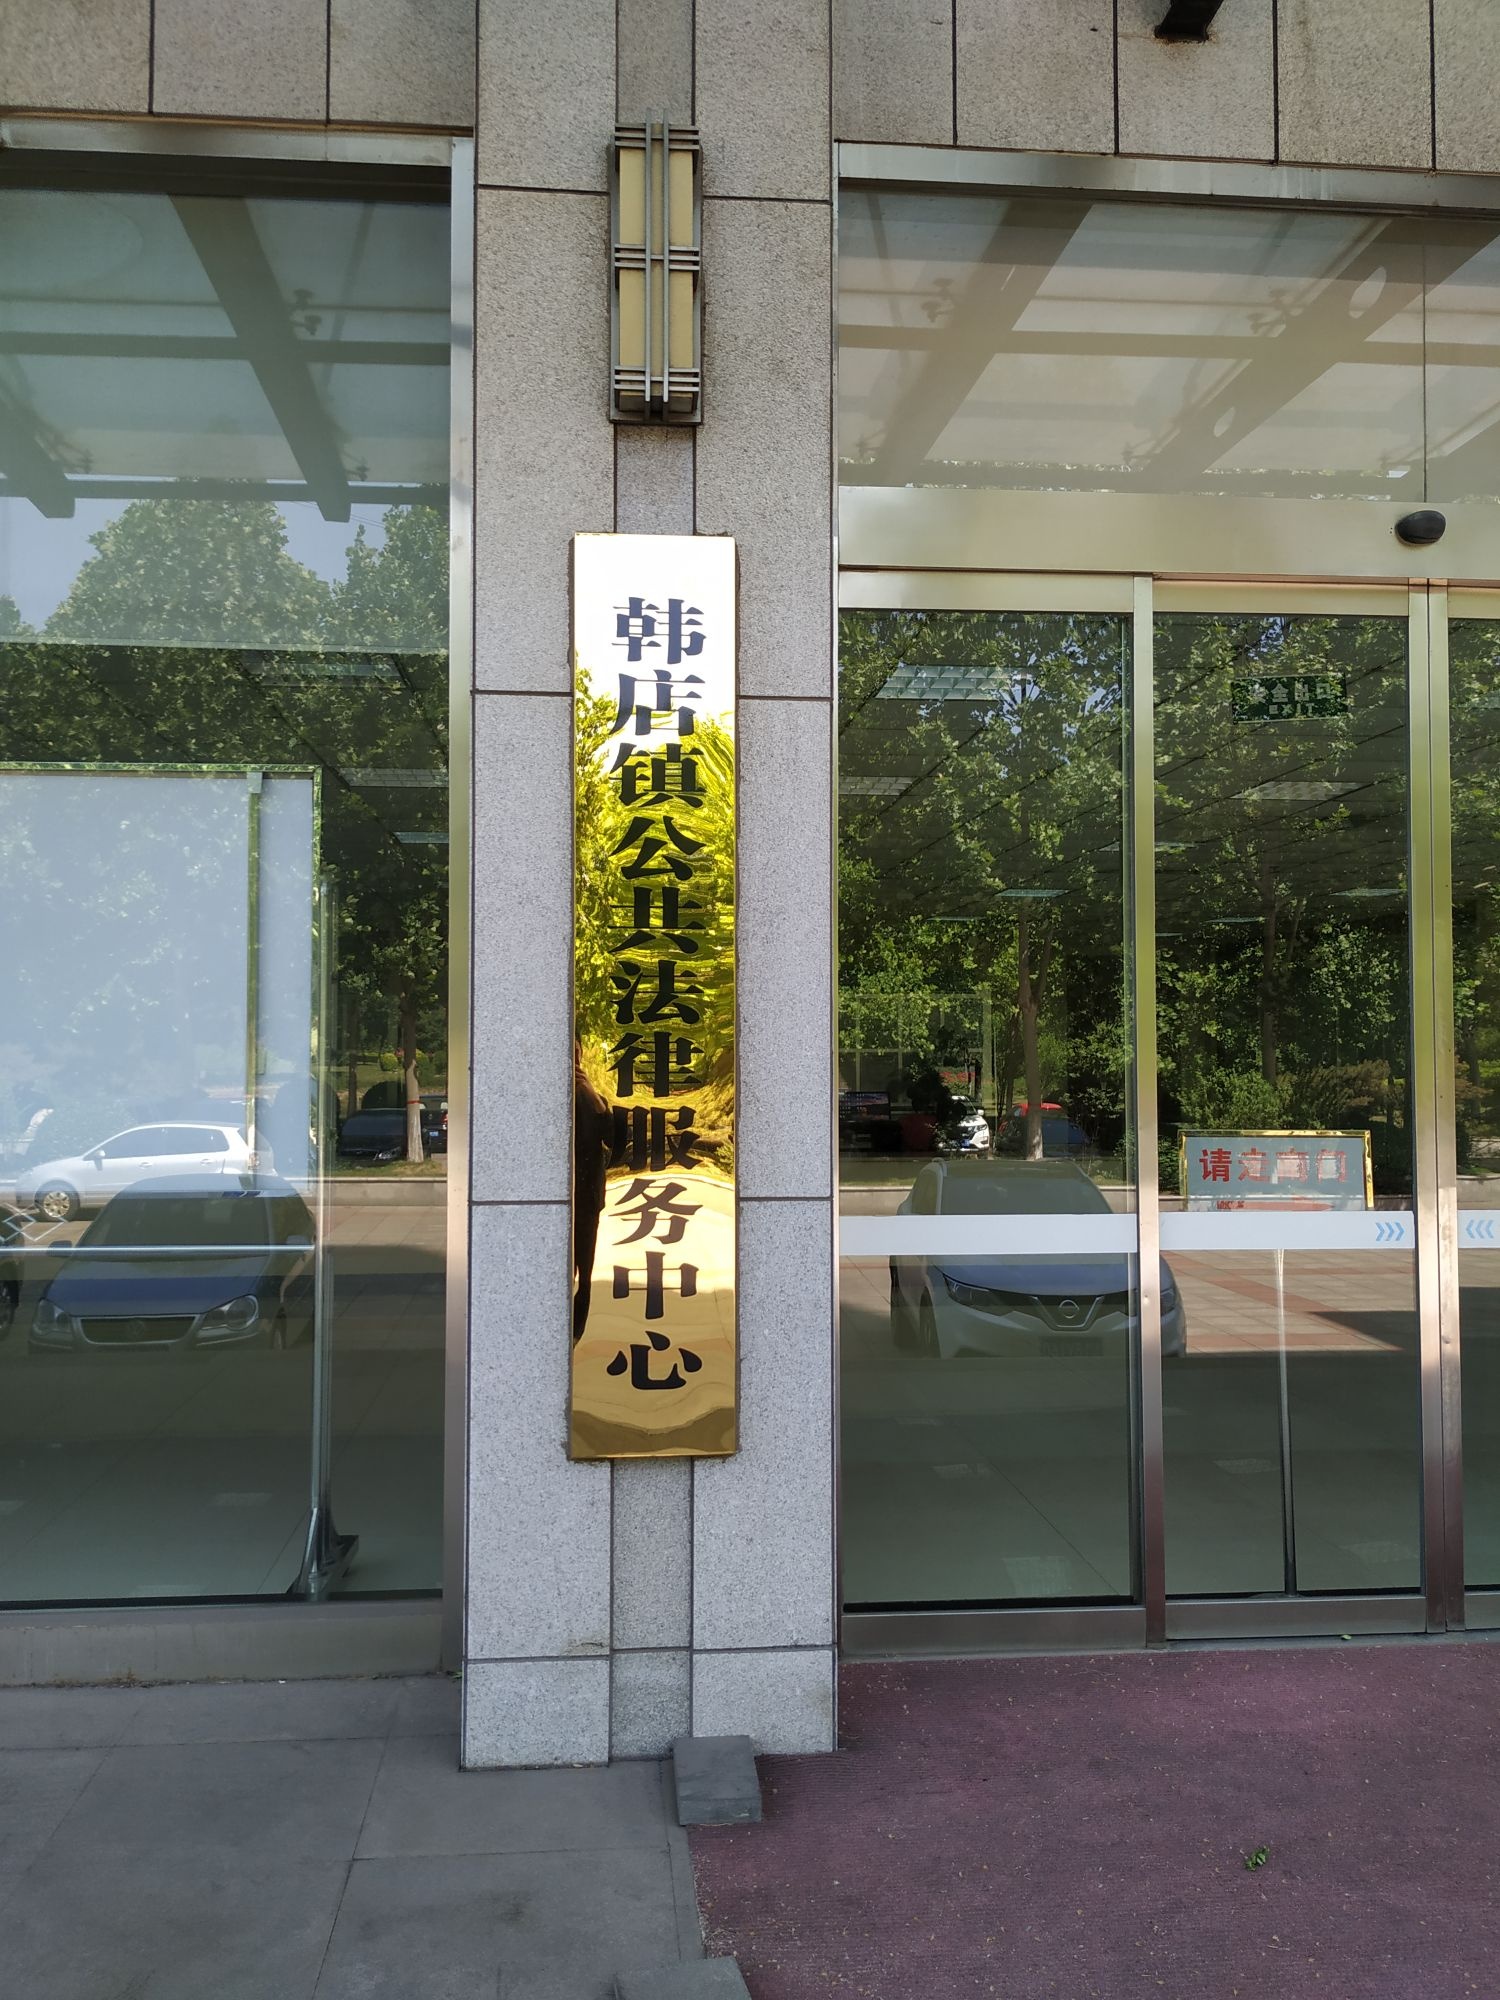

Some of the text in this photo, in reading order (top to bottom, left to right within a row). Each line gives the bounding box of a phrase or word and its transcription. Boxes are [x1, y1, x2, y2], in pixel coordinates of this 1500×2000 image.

[1248, 682, 1331, 705] 安全出口
[1268, 703, 1315, 718] EXIT
[607, 596, 707, 1391] 韩店镇公共法律服务中心
